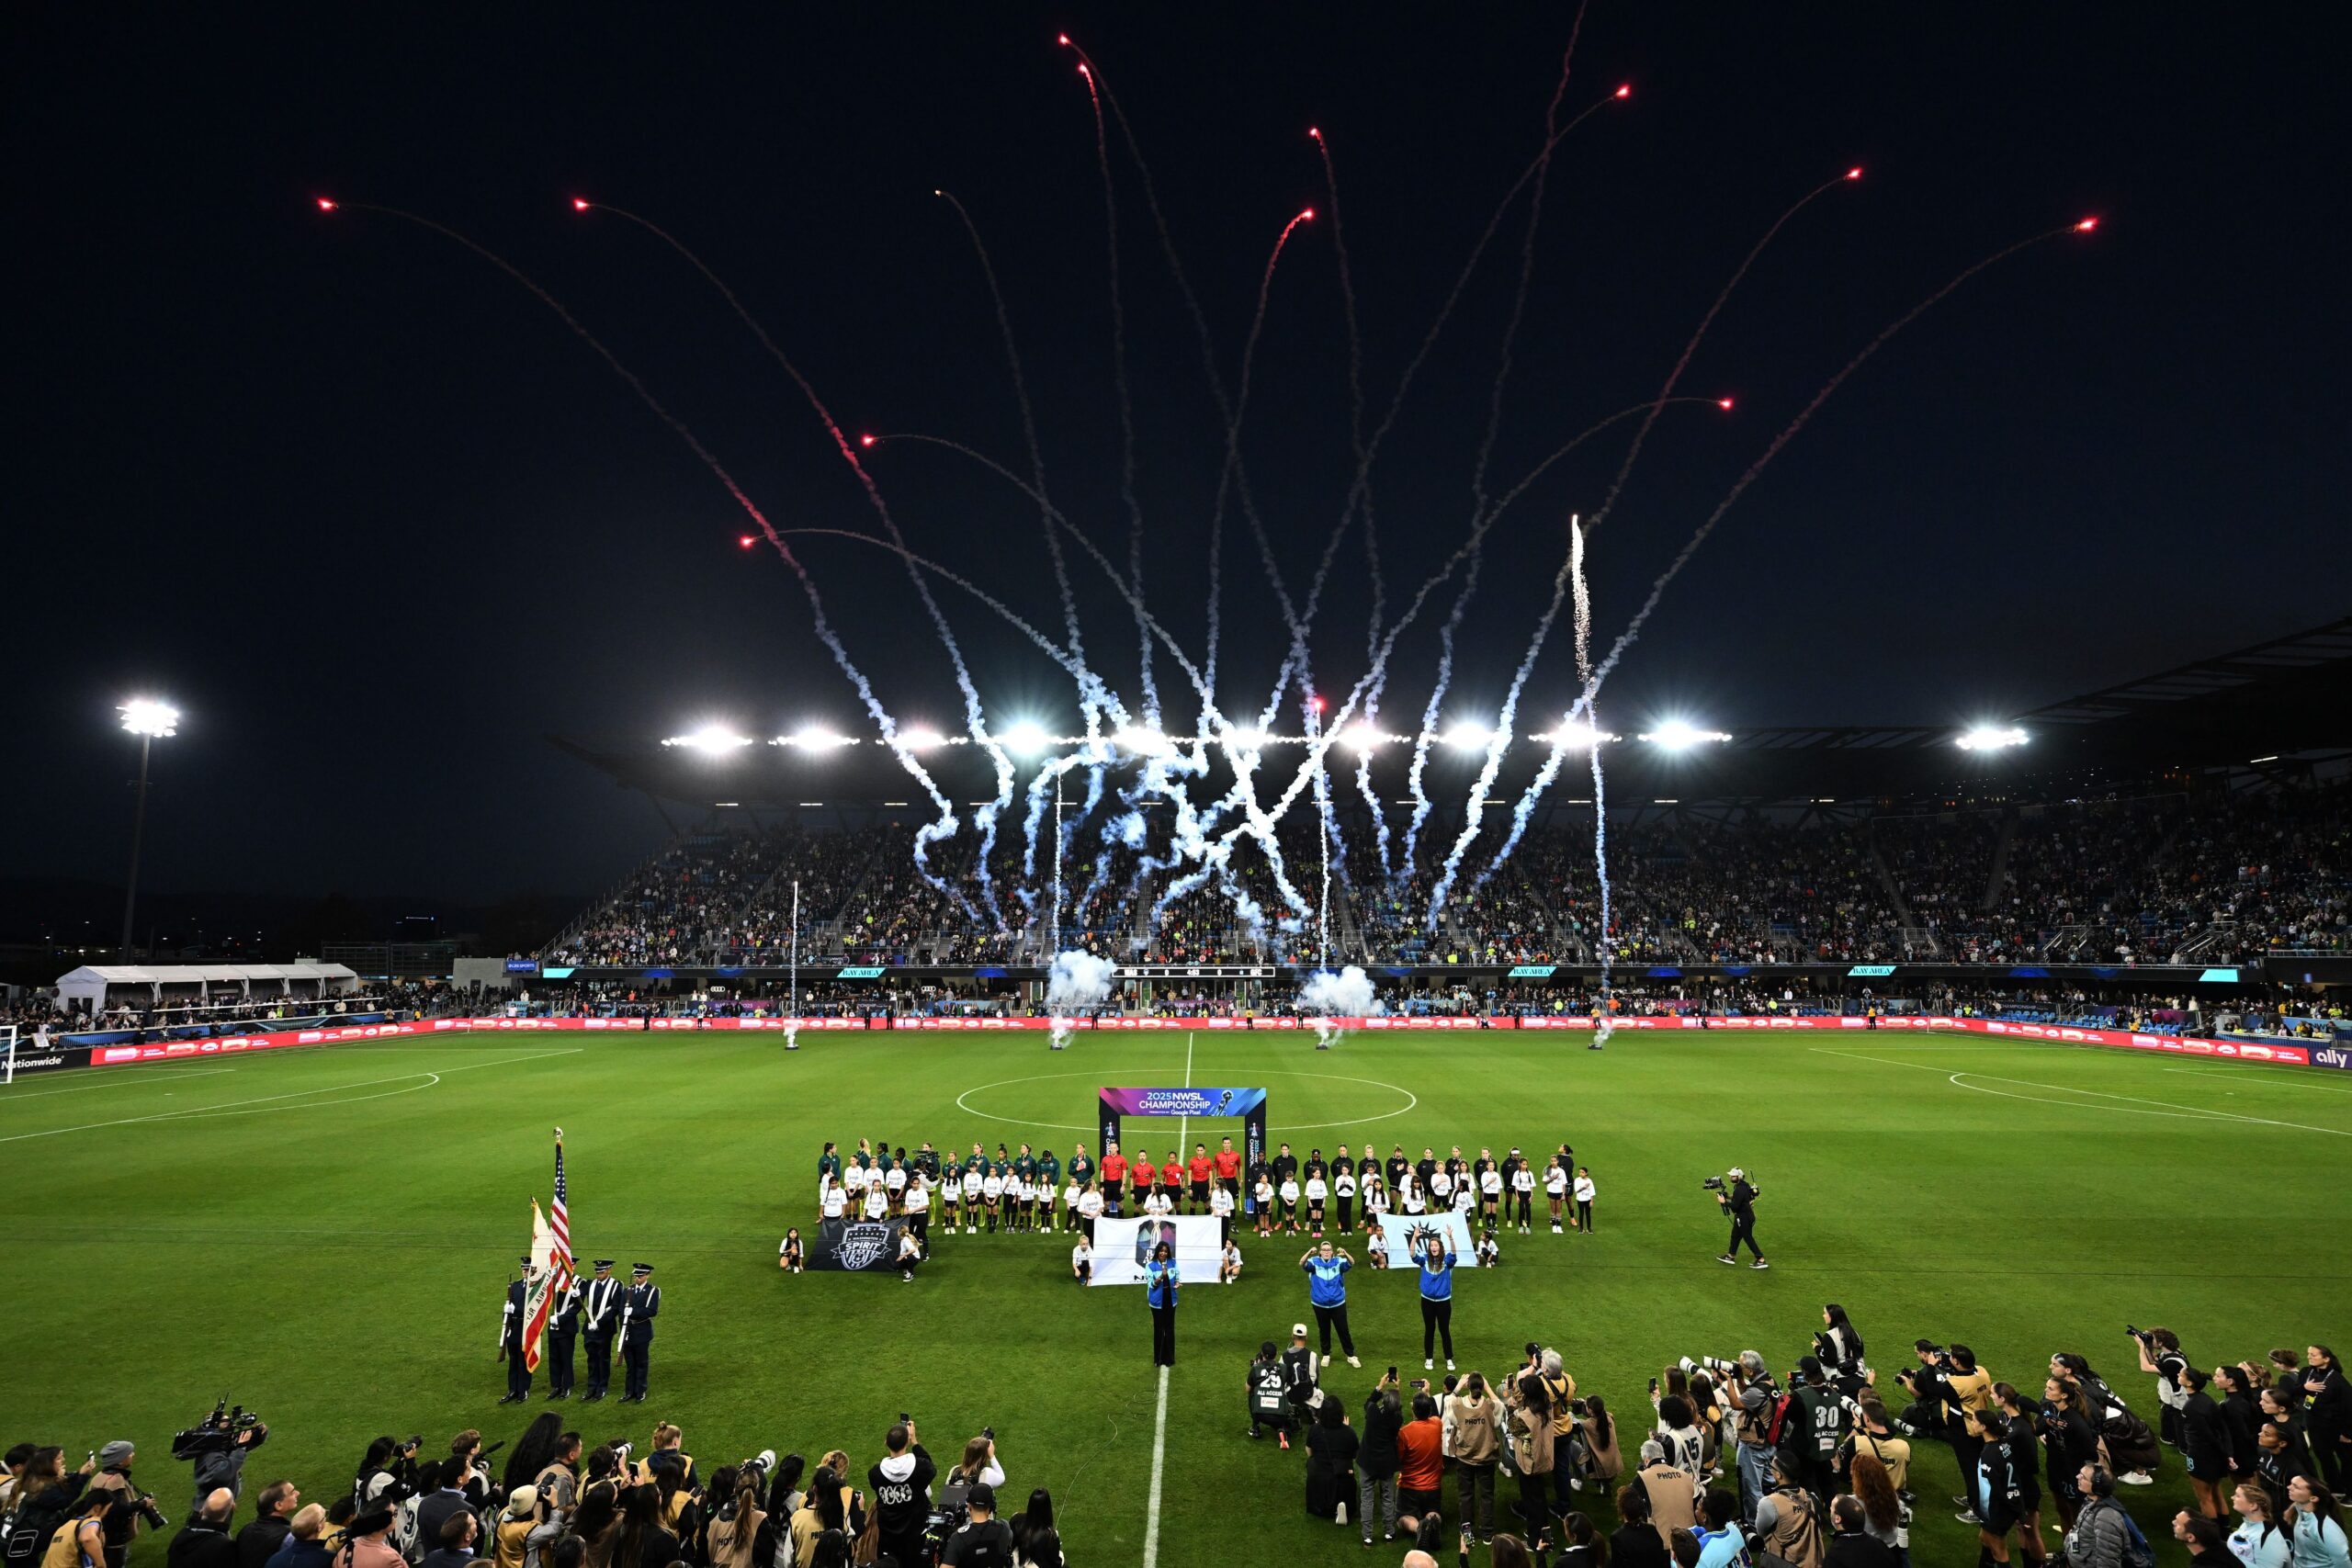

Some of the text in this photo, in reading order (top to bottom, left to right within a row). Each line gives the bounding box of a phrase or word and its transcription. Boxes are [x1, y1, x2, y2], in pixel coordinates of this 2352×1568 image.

[2315, 1049, 2347, 1068] ally
[1147, 1092, 1204, 1100] 2025 NWSL
[1138, 1100, 1211, 1109] CHAMPIONSHIP
[845, 1241, 881, 1251] SPIRIT
[1815, 1405, 1838, 1428] 30
[1657, 1472, 1681, 1480] PHOTO
[2006, 1461, 2017, 1488] 2
